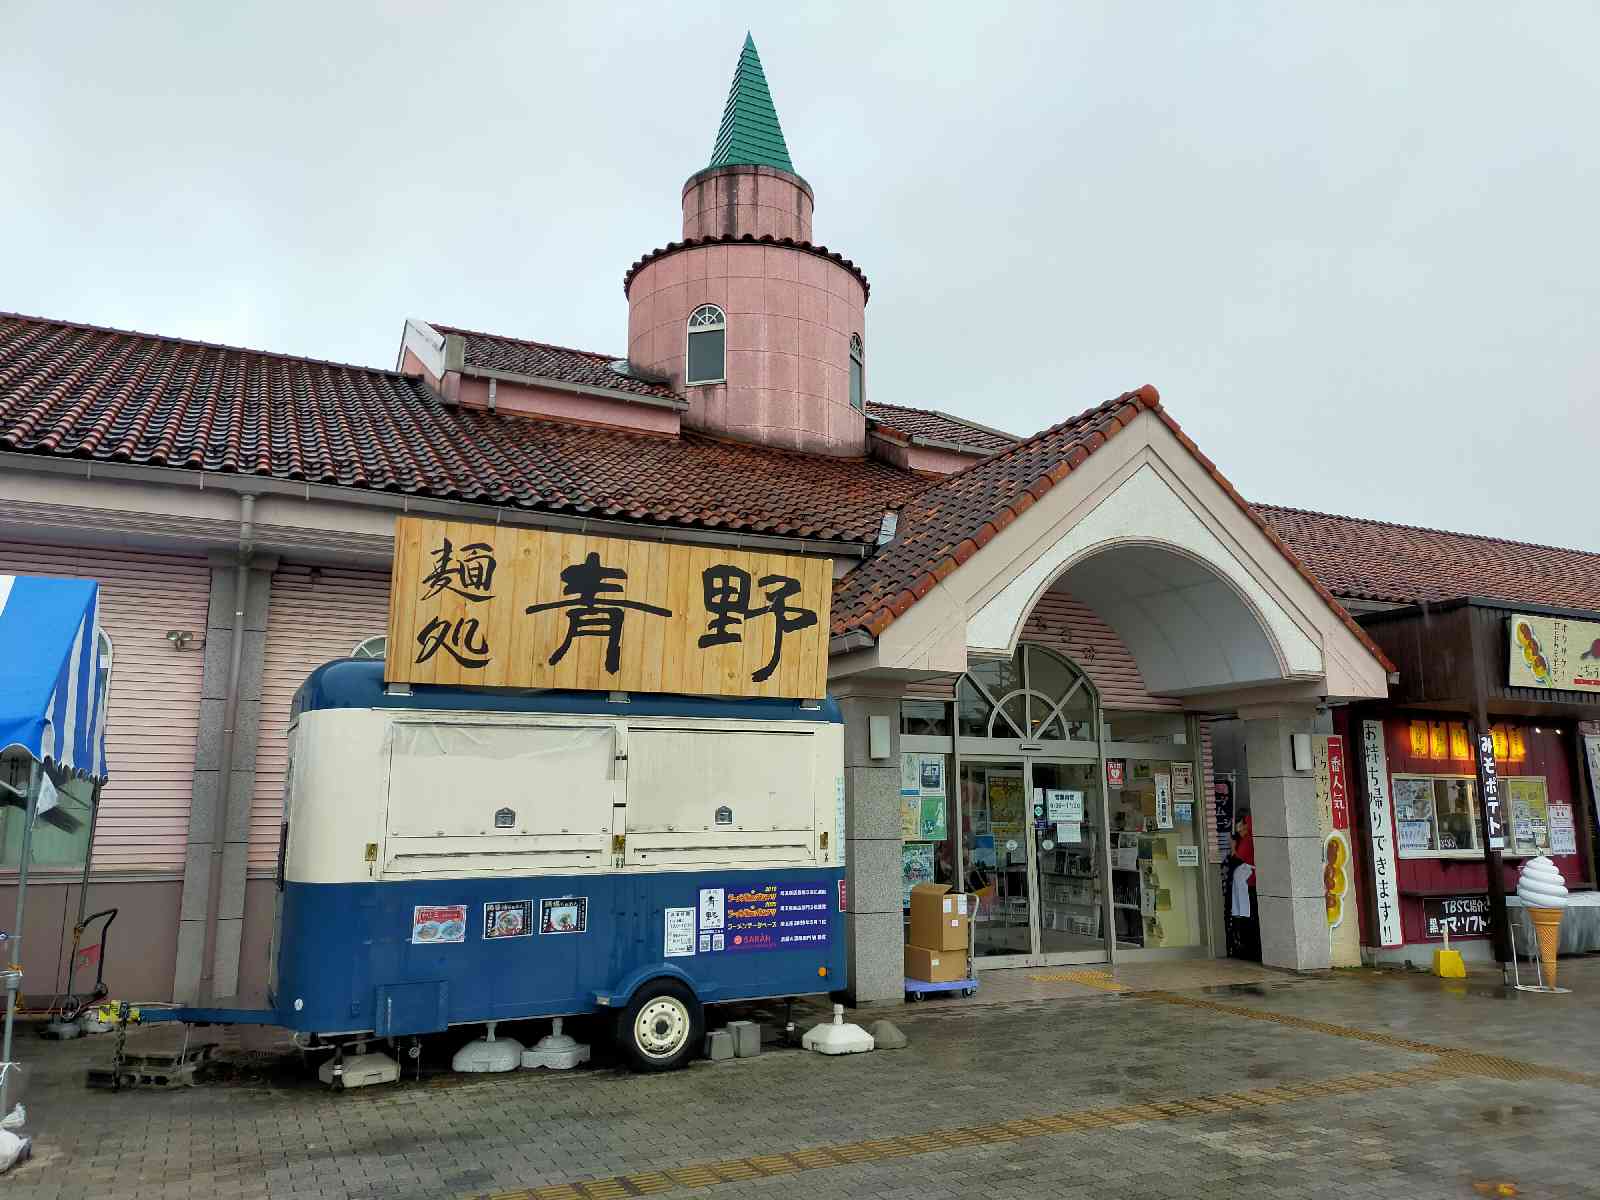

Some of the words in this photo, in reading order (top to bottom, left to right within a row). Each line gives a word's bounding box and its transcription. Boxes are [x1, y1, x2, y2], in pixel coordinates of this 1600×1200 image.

[415, 537, 496, 668] 麺処
[525, 552, 818, 683] 青野
[1481, 736, 1500, 835] みそポテト
